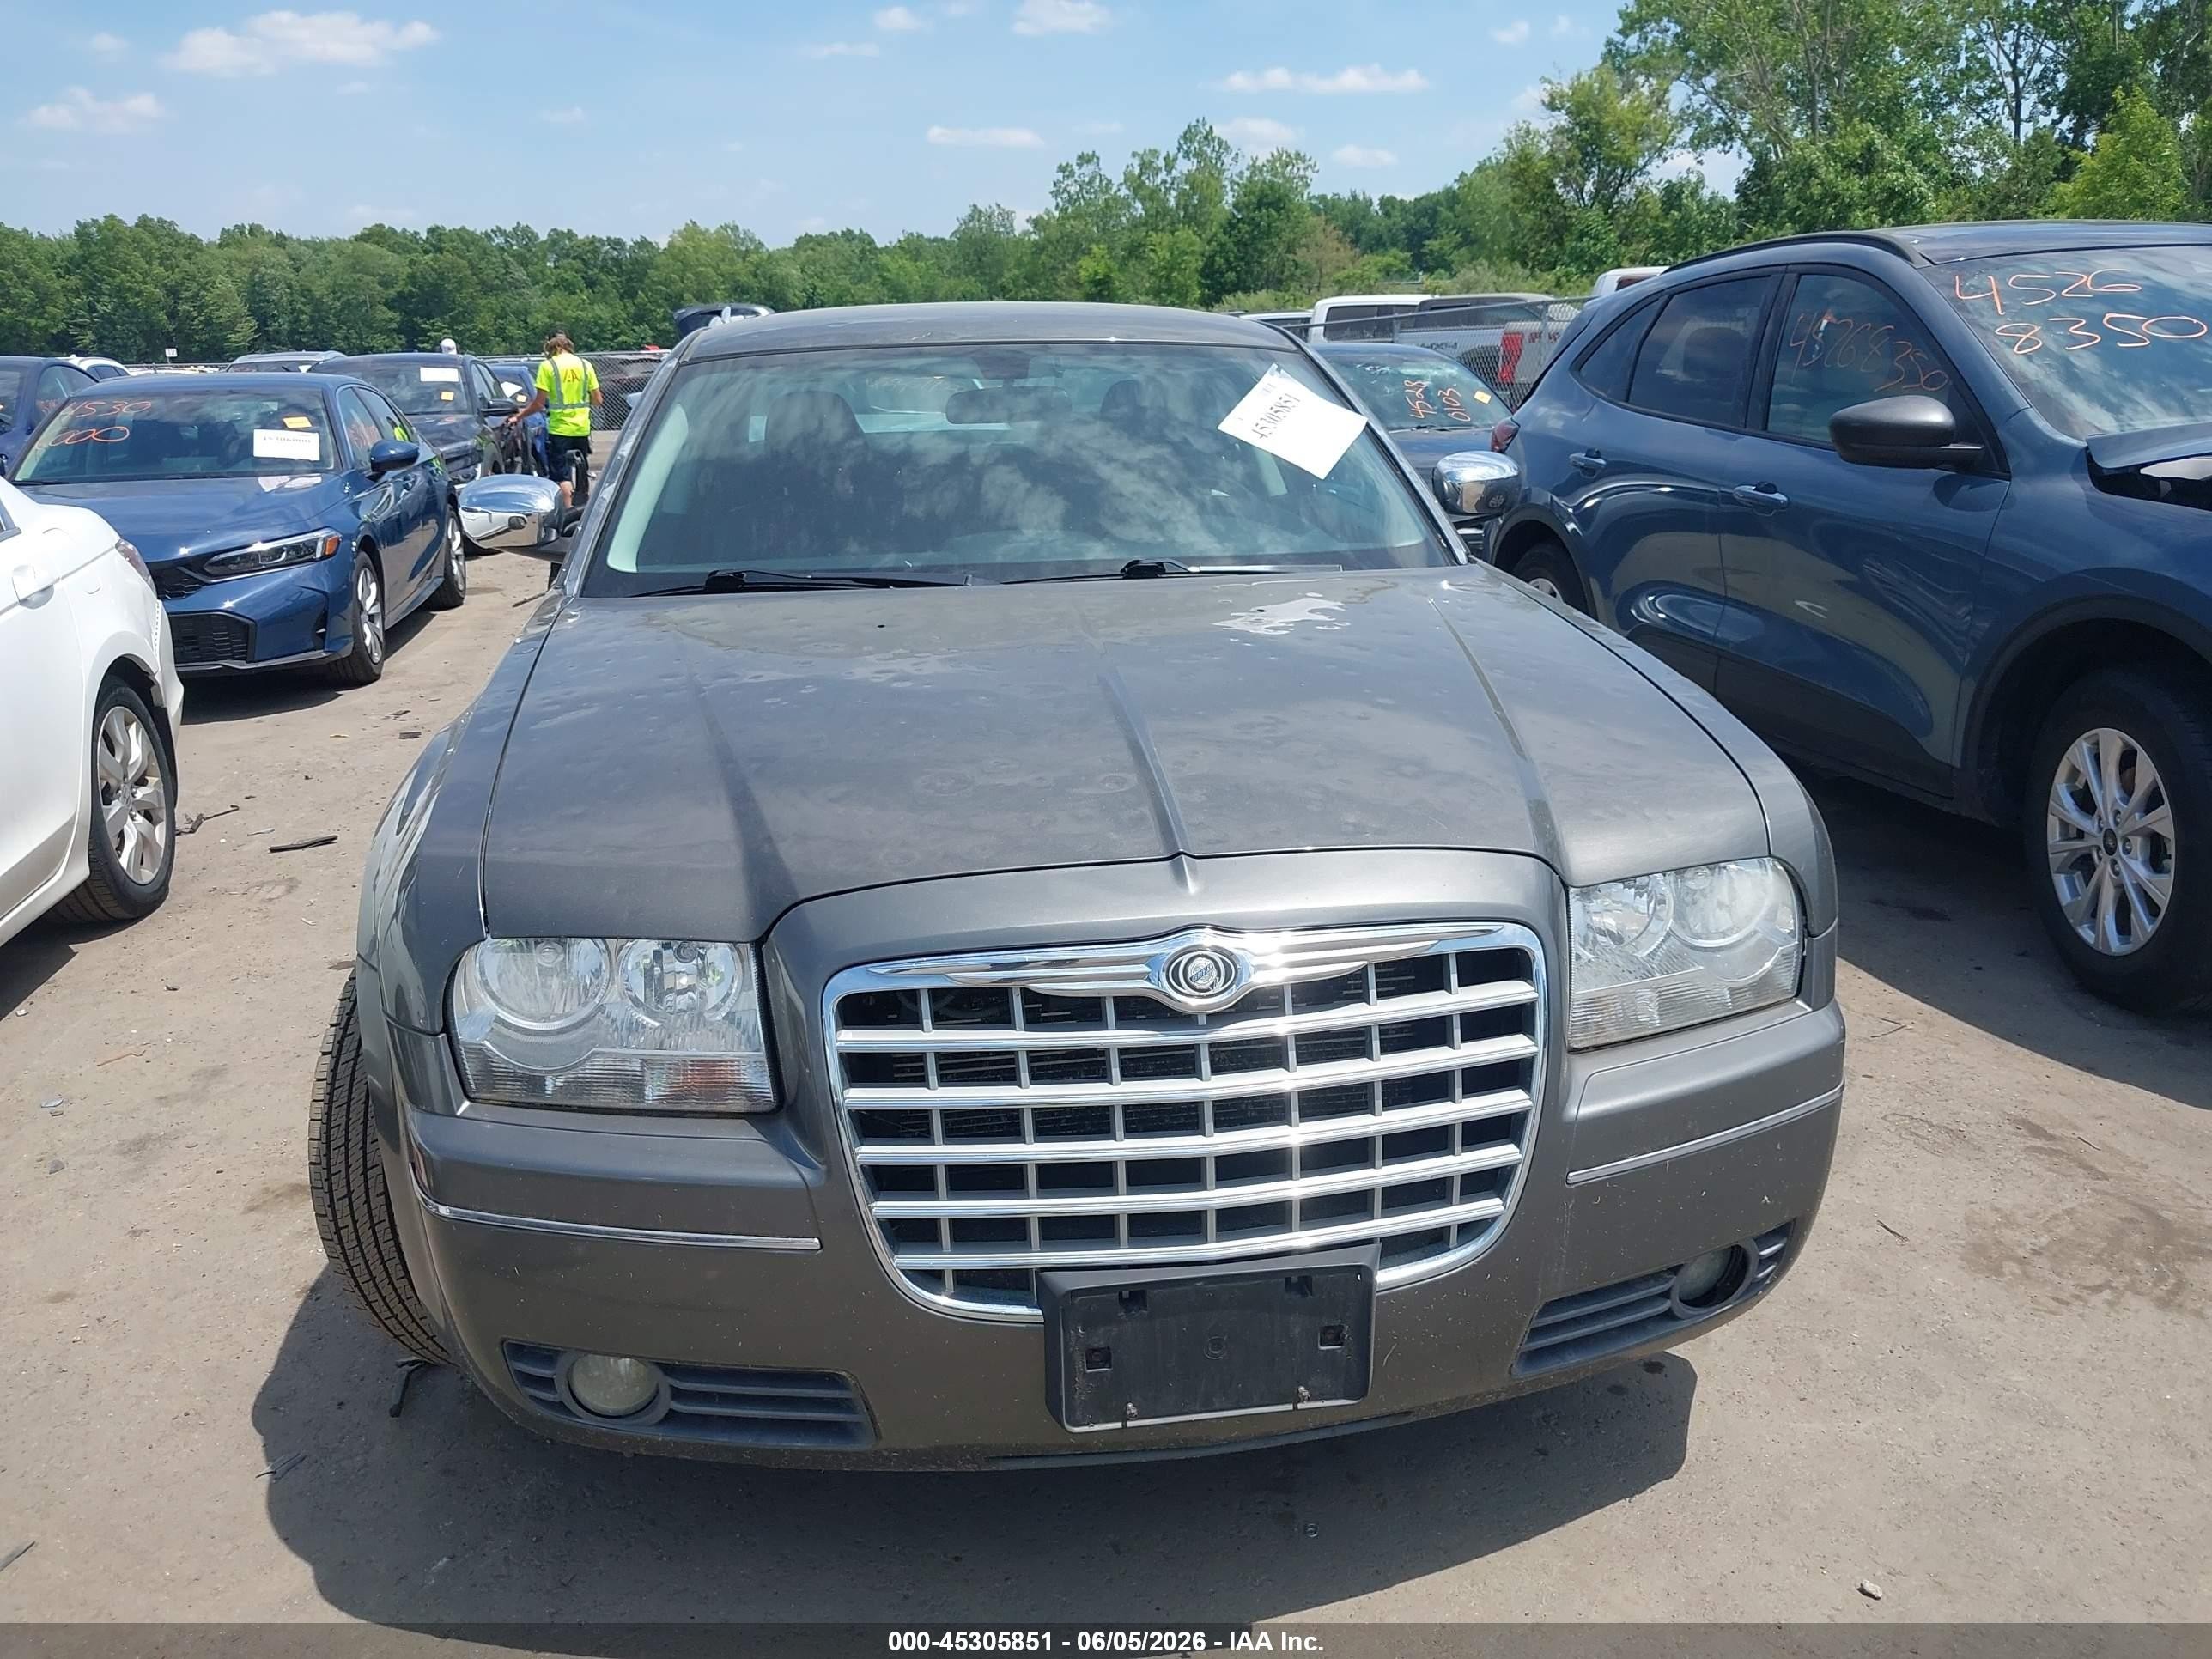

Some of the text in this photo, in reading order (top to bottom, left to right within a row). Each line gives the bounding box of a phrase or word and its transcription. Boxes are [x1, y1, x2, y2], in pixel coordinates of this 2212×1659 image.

[1955, 268, 2142, 315] 4526
[1995, 313, 2208, 355] 8350
[1403, 380, 1438, 419] 4528
[1437, 387, 1471, 422] 0103
